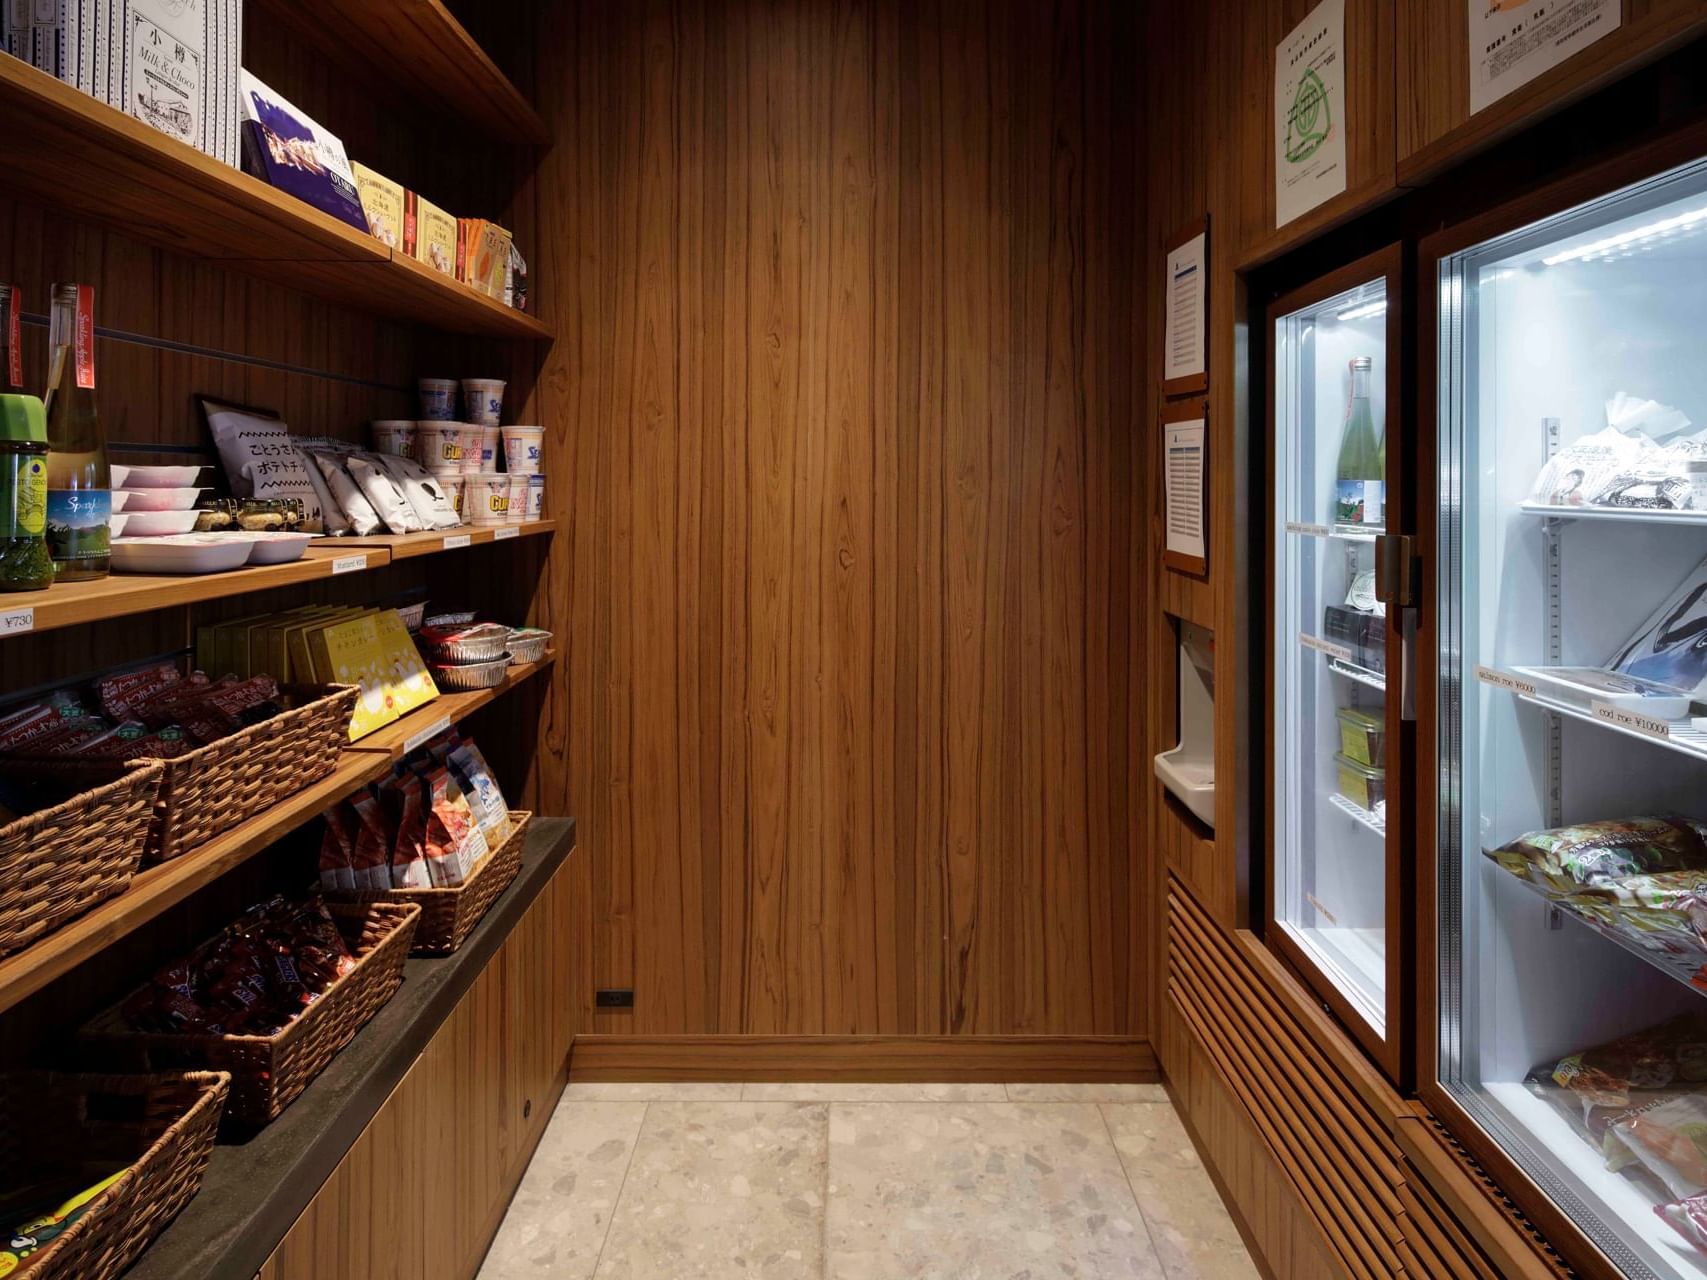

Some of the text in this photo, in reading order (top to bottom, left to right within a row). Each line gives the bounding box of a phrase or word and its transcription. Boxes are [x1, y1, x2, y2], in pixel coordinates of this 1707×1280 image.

[139, 46, 160, 67] Milk
[161, 61, 169, 73] &
[171, 66, 195, 90] Choco
[5, 614, 32, 628] ¥730
[1478, 671, 1536, 694] salmon roe ¥6000
[1599, 707, 1669, 735] cod roe ¥10000
